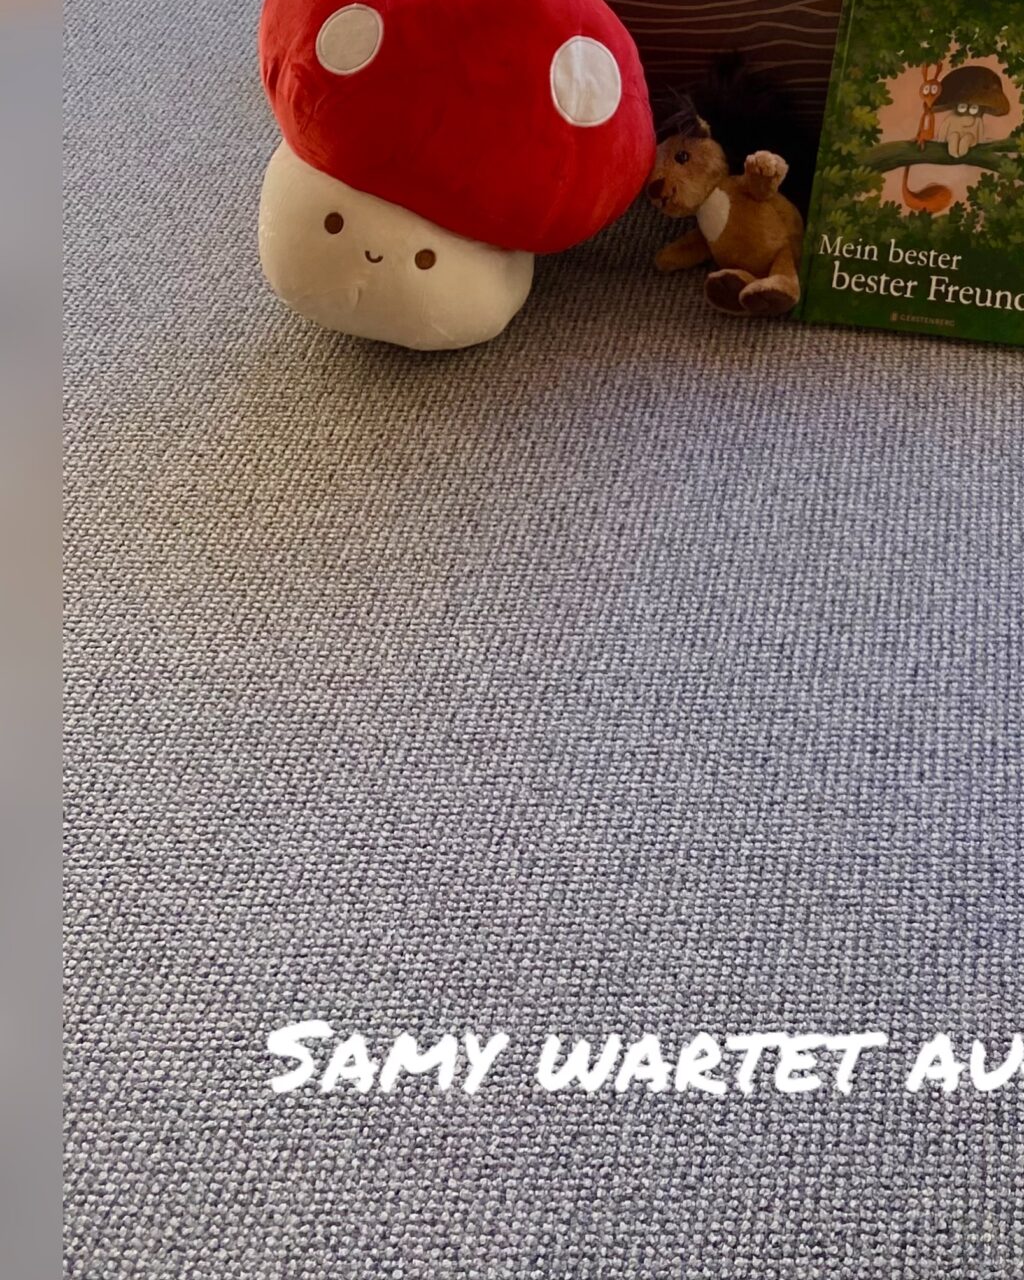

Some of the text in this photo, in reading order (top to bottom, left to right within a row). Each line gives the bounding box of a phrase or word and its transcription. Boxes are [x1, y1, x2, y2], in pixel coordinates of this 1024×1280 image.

[818, 233, 963, 271] Mein bester
[831, 260, 919, 299] bester
